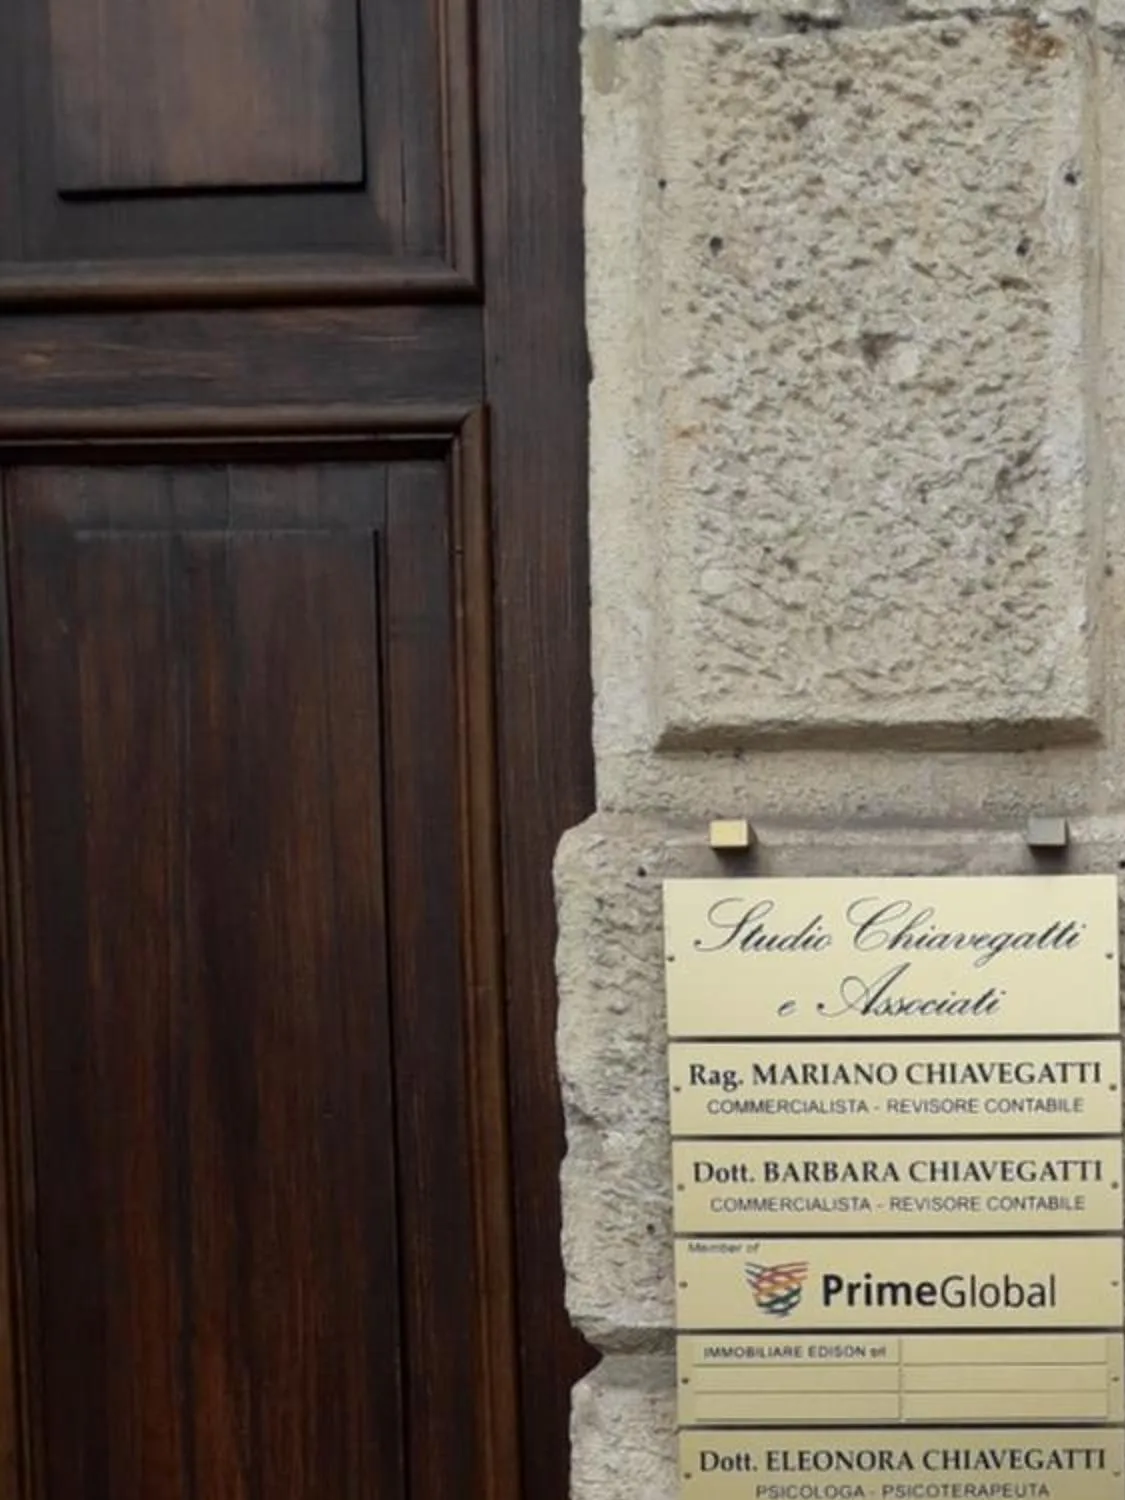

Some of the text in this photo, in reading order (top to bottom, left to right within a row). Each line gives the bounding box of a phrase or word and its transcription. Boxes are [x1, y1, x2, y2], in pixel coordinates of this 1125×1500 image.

[694, 896, 1088, 967] Studio Chiavegatti
[778, 962, 1007, 1017] e Associati
[688, 1062, 1101, 1093] Rag. MARIANO CHIAVEGATTI
[707, 1099, 869, 1115] COMMERCIALISTA
[886, 1098, 980, 1114] REVISORE
[984, 1097, 1084, 1114] CONTABILE
[693, 1159, 1103, 1184] Dott. BARBARA CHIAVEGATTI
[710, 1197, 872, 1213] COMMERCIALISTA
[889, 1196, 982, 1212] REVISORE
[986, 1195, 1086, 1212] CONTABILE
[822, 1273, 1056, 1308] PrimeGlobal
[704, 1346, 803, 1358] IMMOBILIARE
[808, 1345, 866, 1358] EDISON
[699, 1448, 1106, 1472] Dott. ELEONORA CHIAVEGATTI
[756, 1485, 865, 1500] PSICOLOGA
[882, 1483, 1050, 1499] PSICOTERAPEUTA
